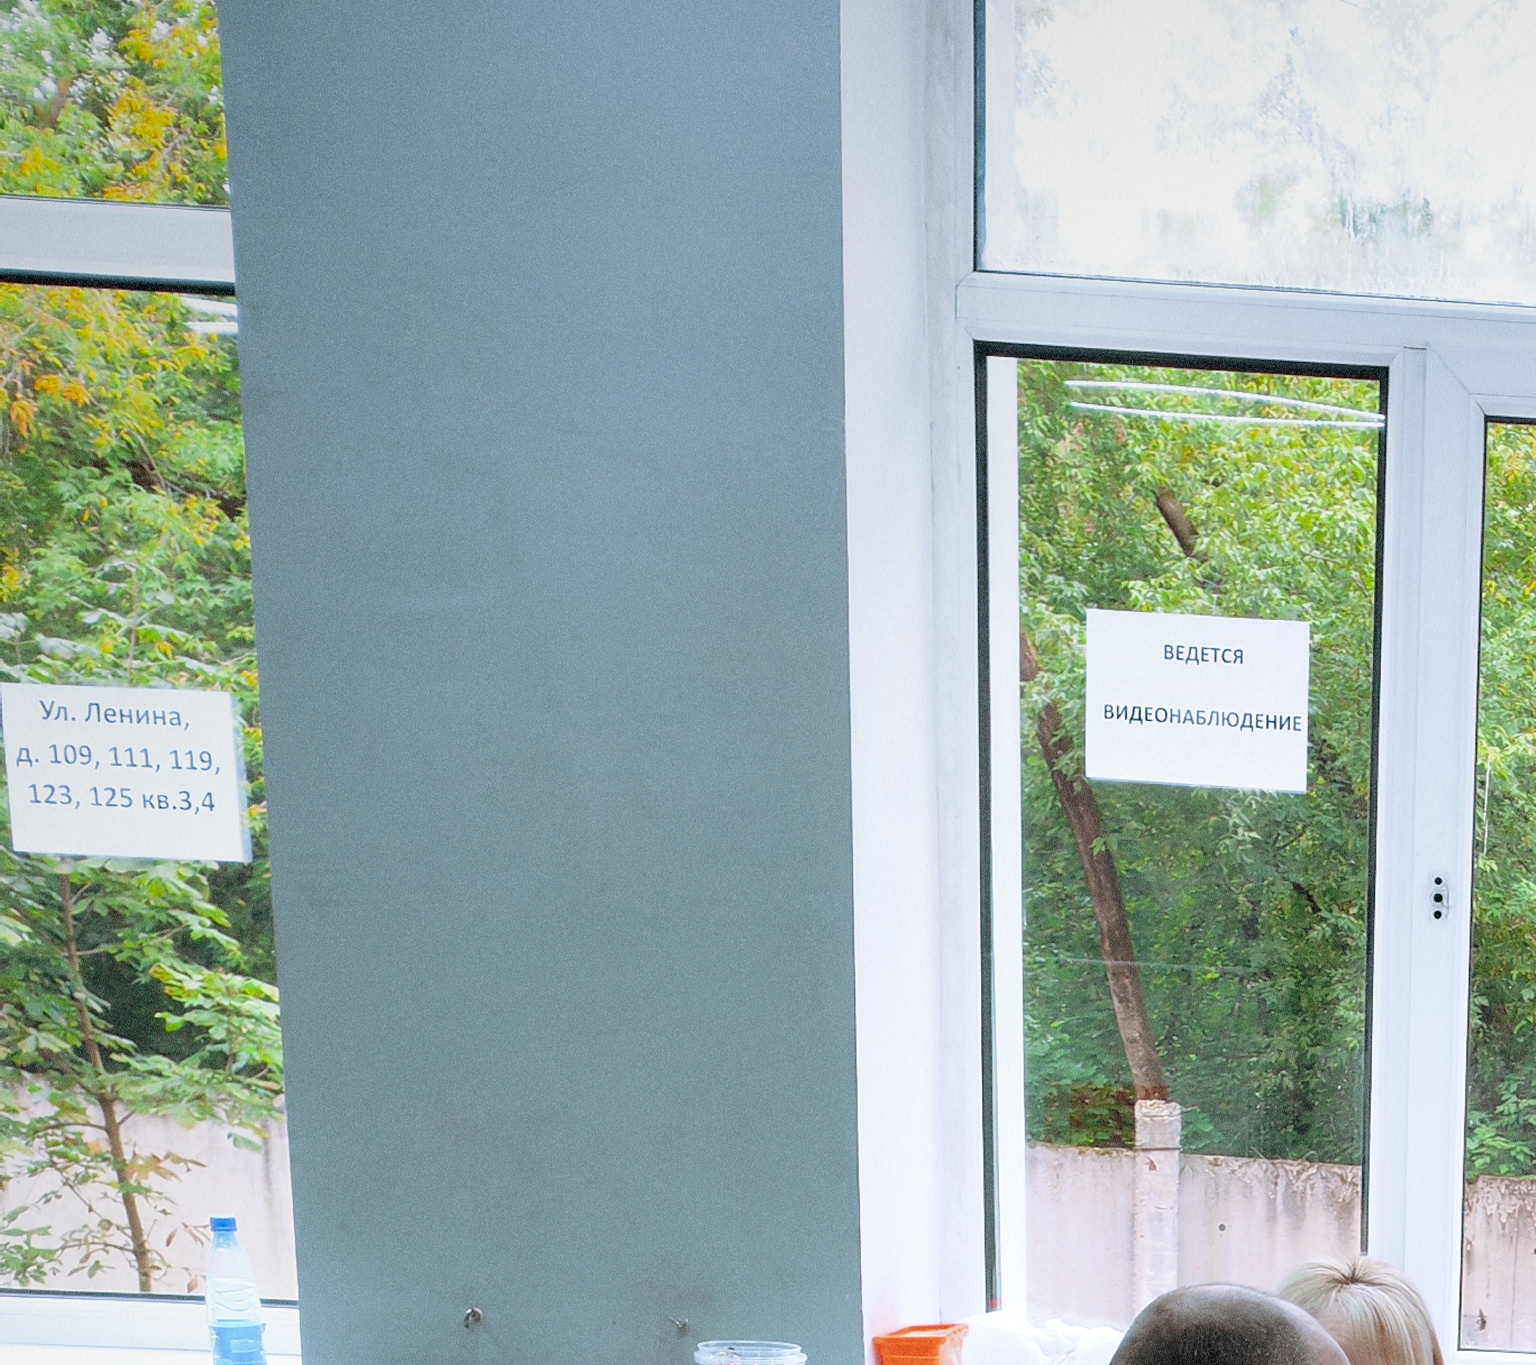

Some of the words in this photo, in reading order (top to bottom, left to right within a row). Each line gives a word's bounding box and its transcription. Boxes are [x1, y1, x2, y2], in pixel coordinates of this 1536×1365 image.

[1163, 644, 1245, 665] ВЕДЕТСЯ
[39, 699, 76, 722] Ул.
[84, 702, 191, 731] Ленина,
[1103, 703, 1303, 733] ВИДЕОНАБЛЮДЕНИЕ
[15, 747, 40, 768] д.
[48, 743, 101, 770] 109,
[108, 746, 162, 773] 111,
[169, 749, 222, 776] 119,
[27, 783, 81, 810] 123,
[89, 786, 134, 809] 125
[142, 790, 216, 816] кв.3,4
